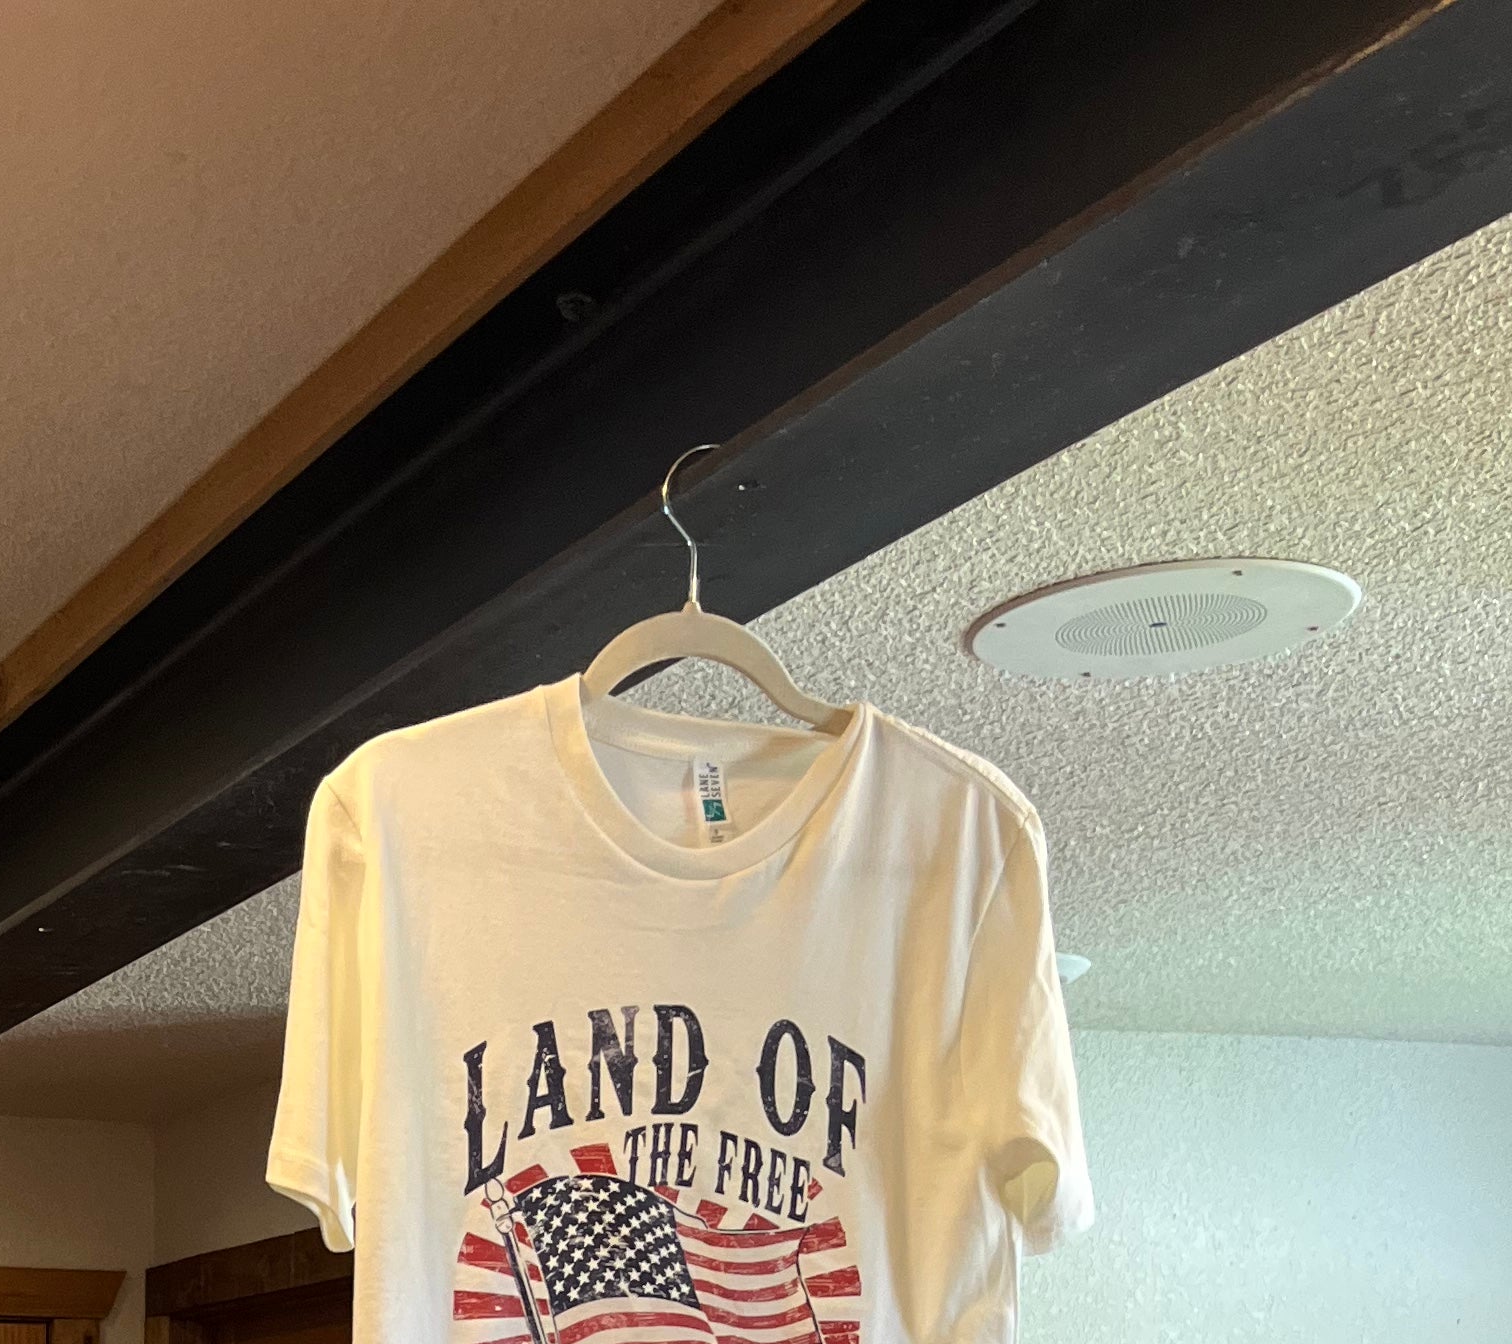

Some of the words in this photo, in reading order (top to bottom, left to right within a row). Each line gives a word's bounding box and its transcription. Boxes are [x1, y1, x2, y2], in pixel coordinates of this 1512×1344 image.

[698, 773, 710, 798] LANE
[463, 1003, 710, 1197] LAND
[755, 1018, 867, 1178] OF
[623, 1122, 699, 1188] THE
[714, 1129, 811, 1224] FREE
